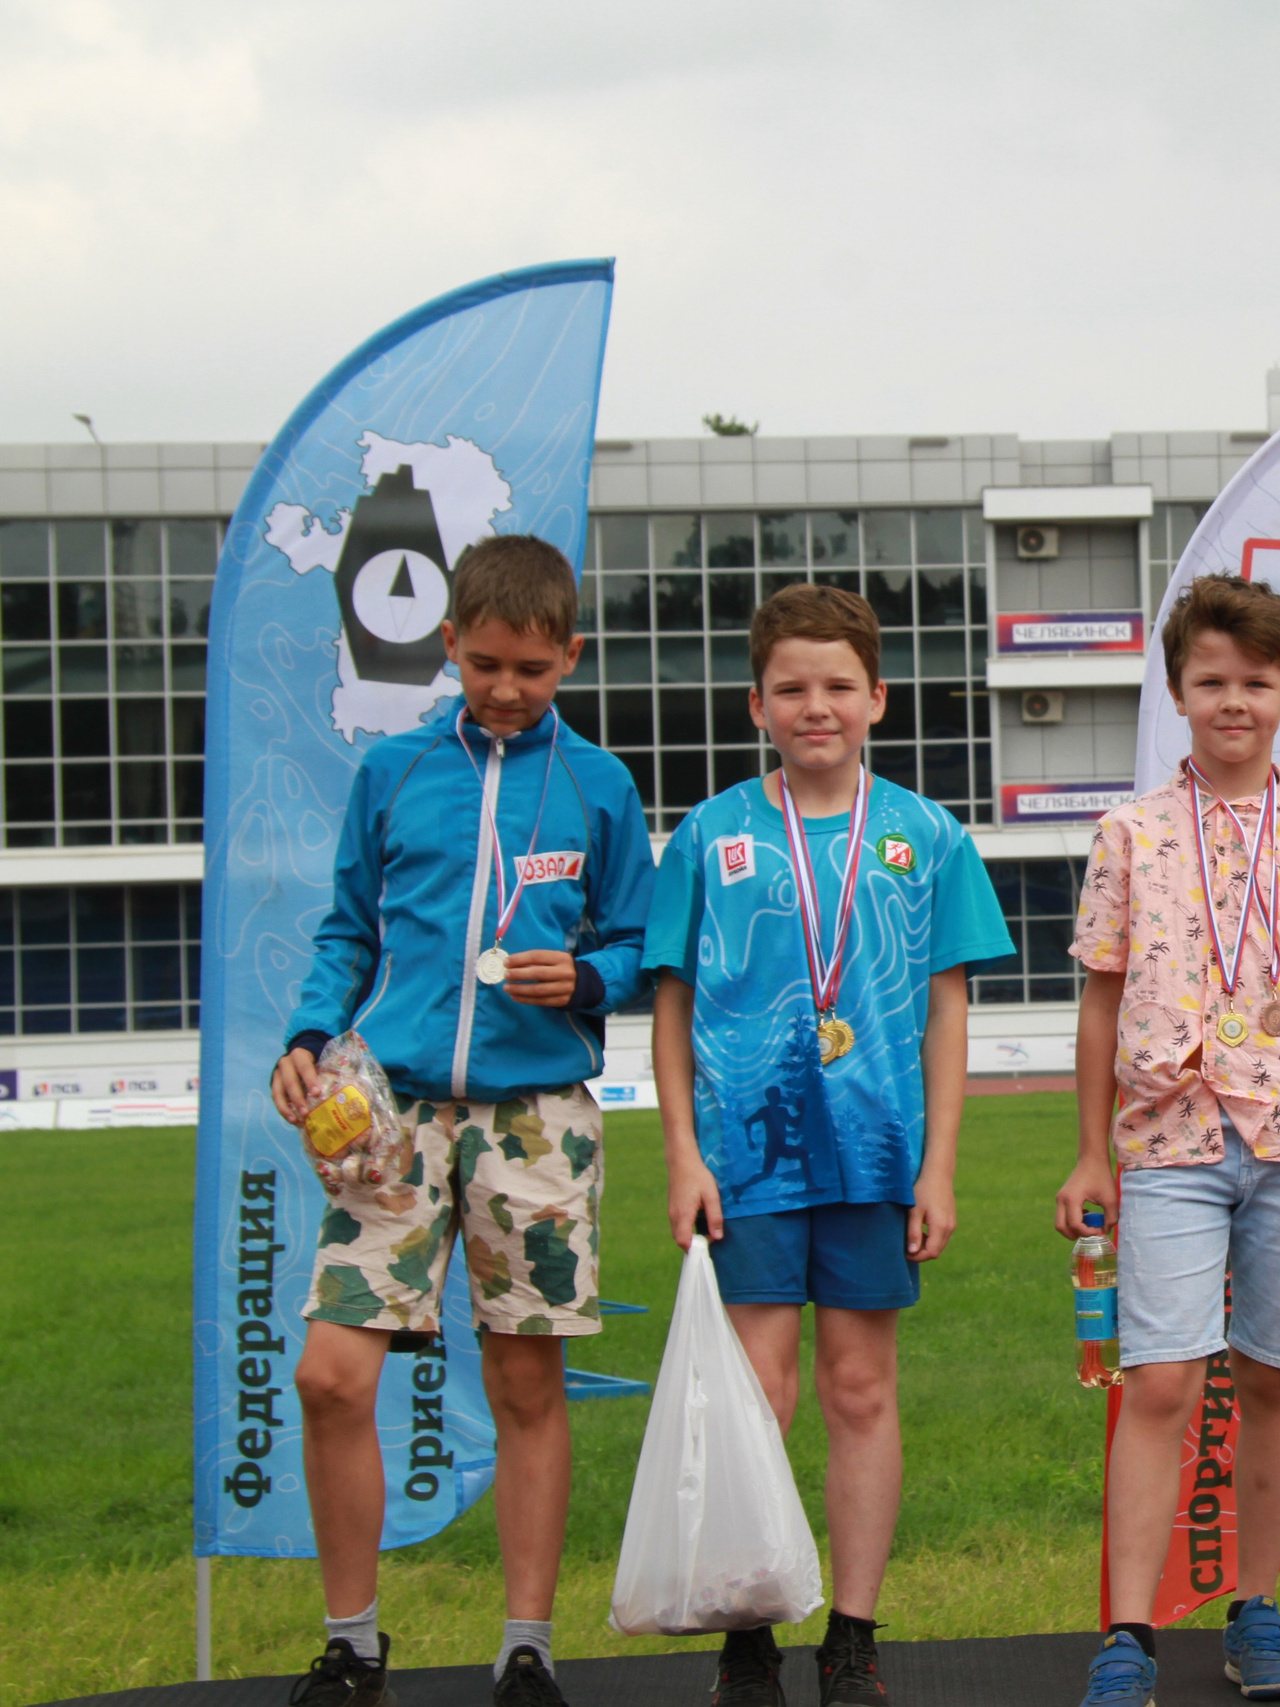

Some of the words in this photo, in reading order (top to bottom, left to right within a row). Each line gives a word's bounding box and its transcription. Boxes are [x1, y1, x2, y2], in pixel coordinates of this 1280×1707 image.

[1015, 624, 1127, 640] ЧЕЛЯБИНСК
[224, 1170, 285, 1508] Федерация
[404, 1325, 454, 1502] орие
